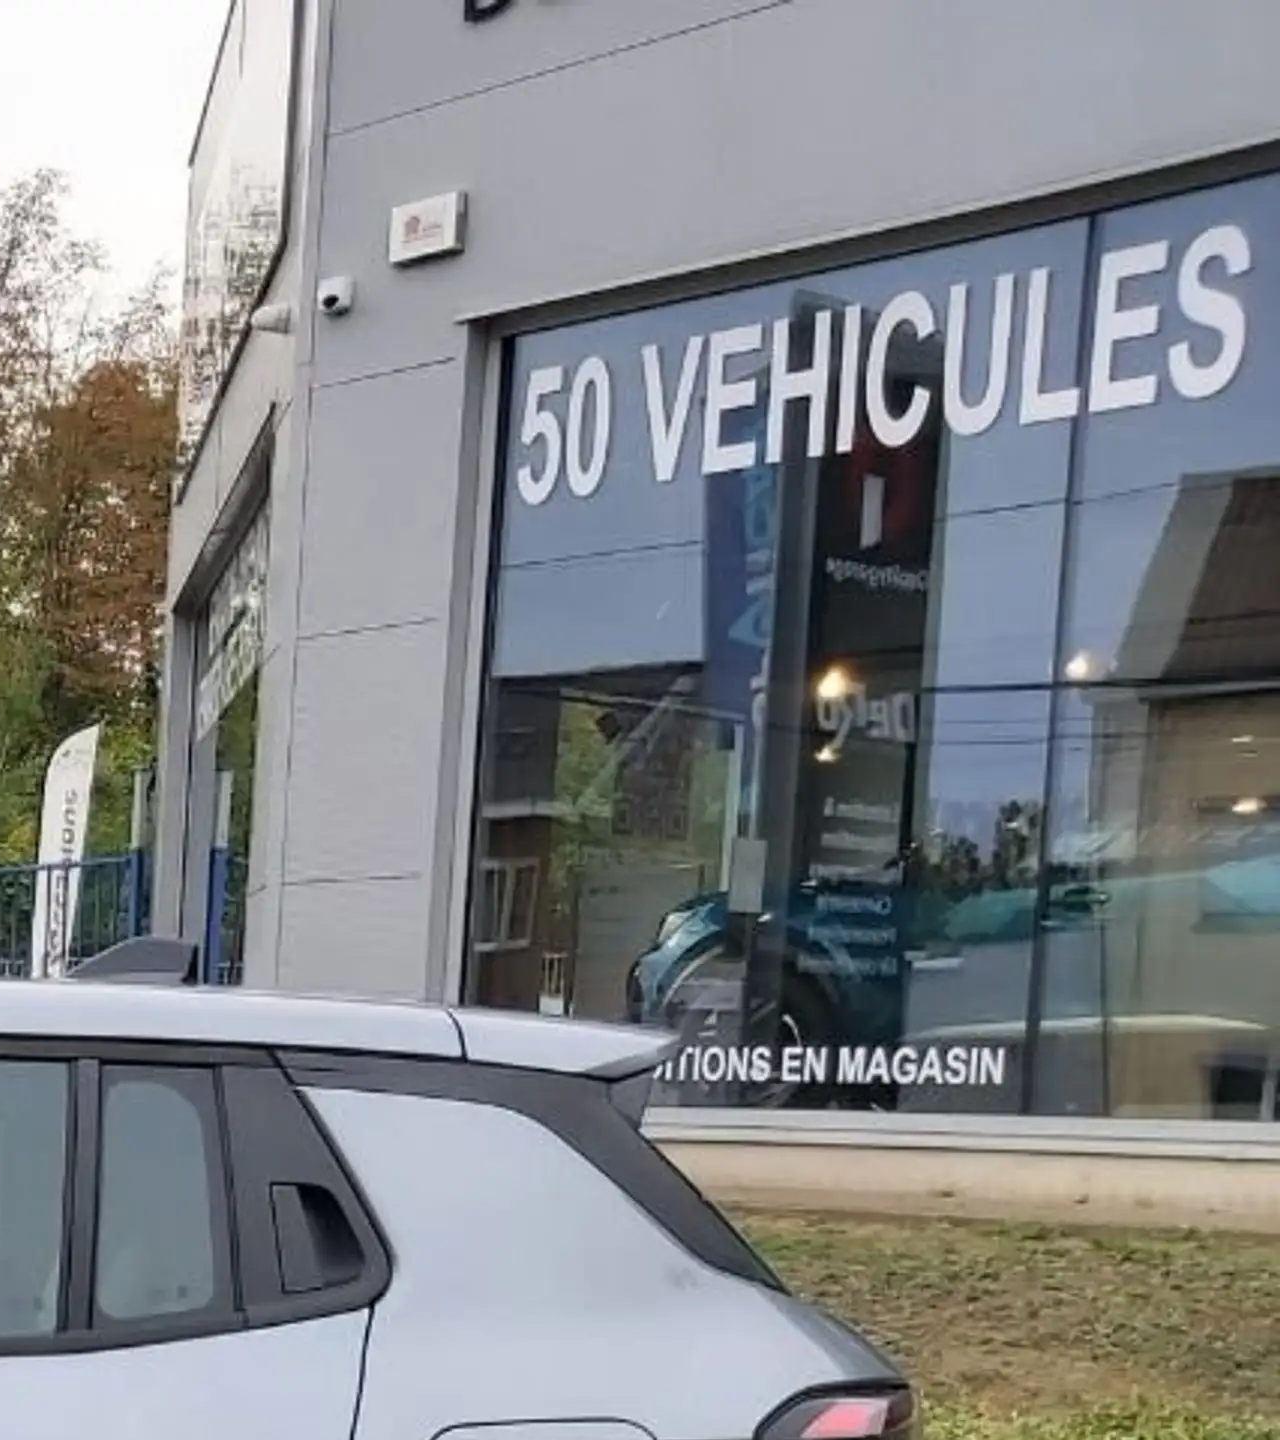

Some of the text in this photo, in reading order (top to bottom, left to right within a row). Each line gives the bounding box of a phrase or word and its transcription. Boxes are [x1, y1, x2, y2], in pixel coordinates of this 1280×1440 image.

[517, 223, 1253, 506] 50 VEHICULES
[780, 1046, 829, 1082] EN
[837, 1046, 1006, 1086] MAGASIN
